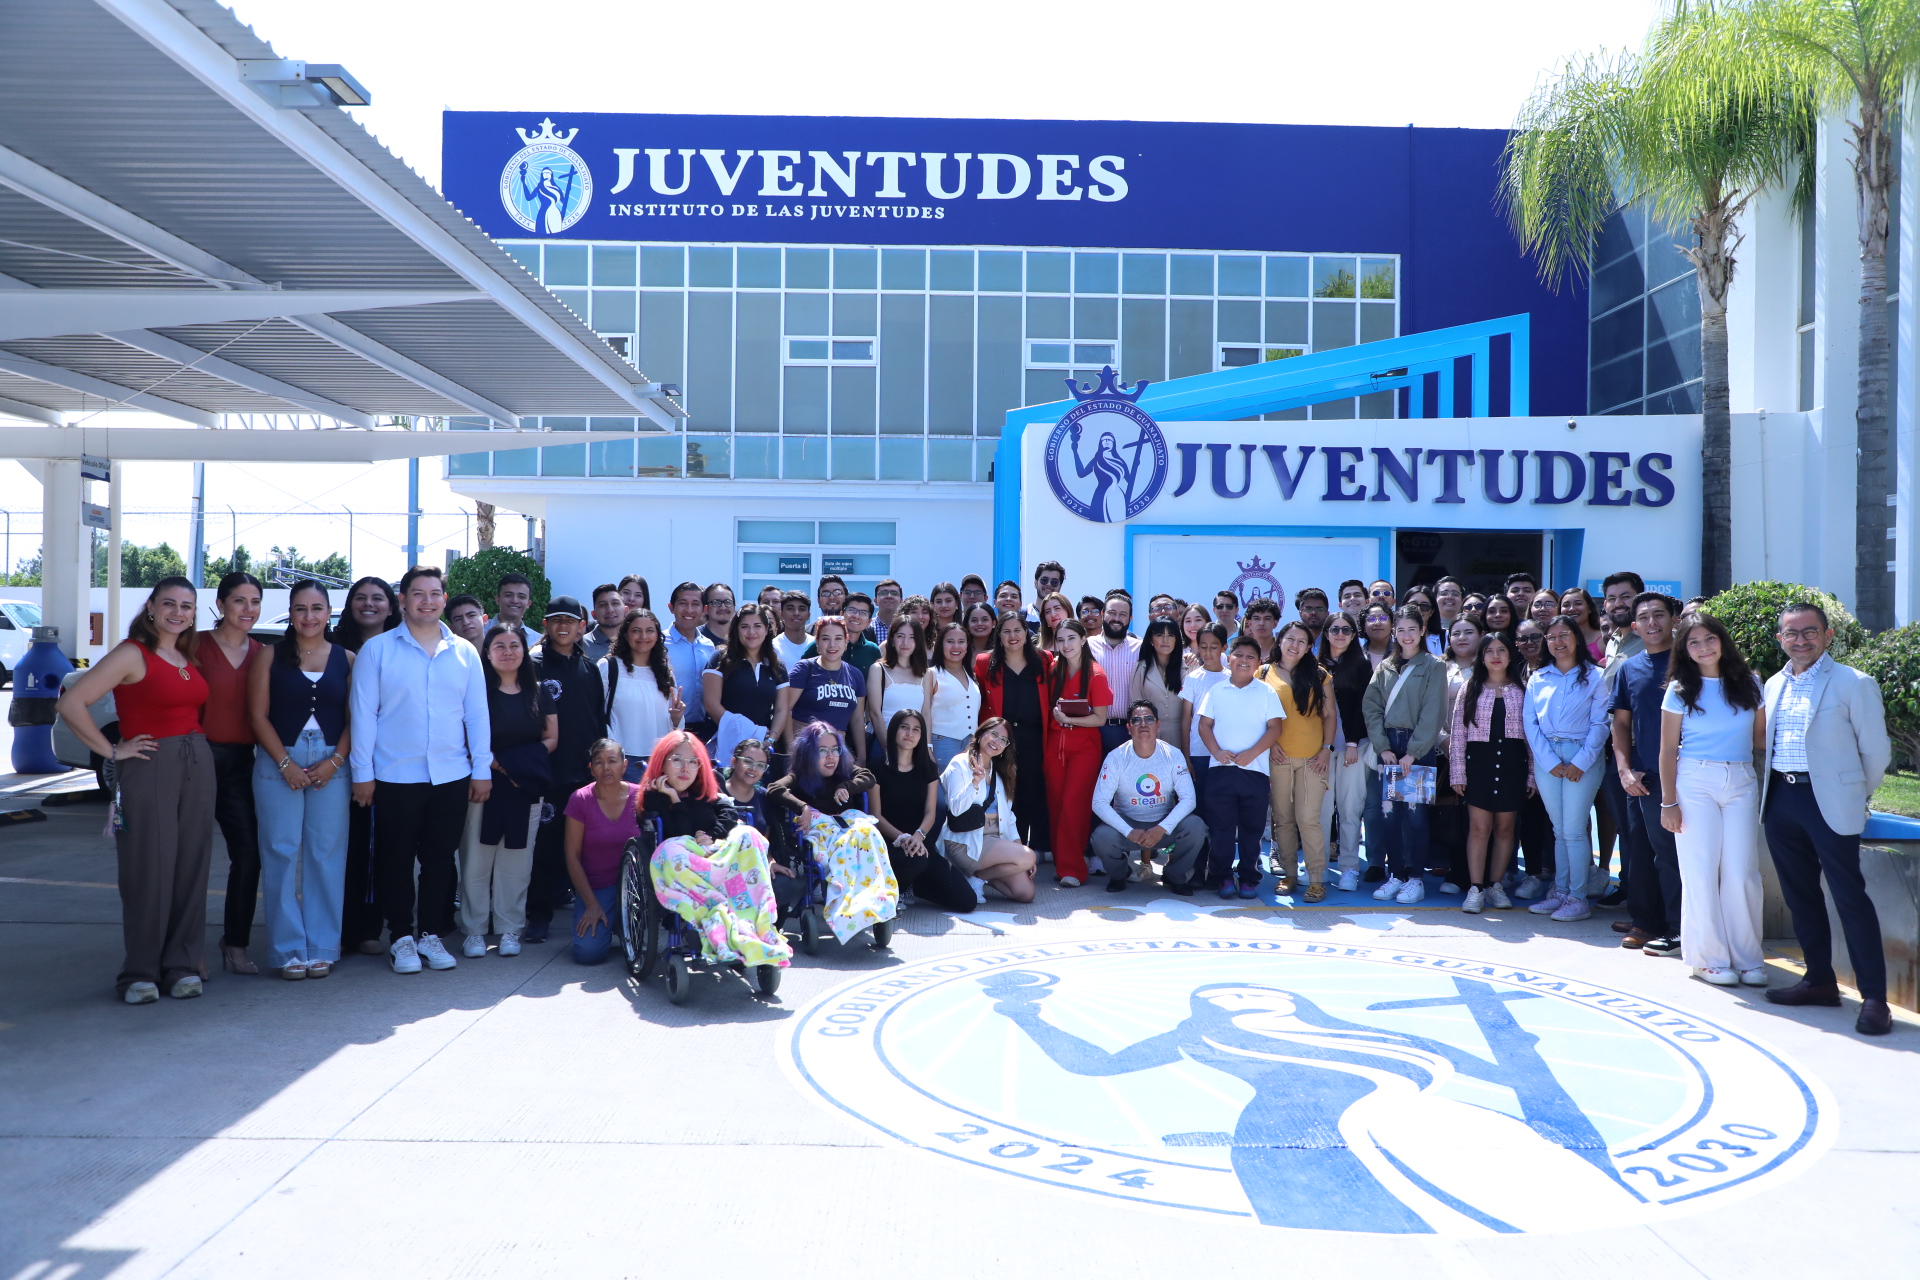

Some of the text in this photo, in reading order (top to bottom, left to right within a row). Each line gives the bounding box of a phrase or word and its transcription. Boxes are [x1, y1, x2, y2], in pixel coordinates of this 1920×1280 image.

[503, 158, 519, 190] GOBIERNO
[519, 149, 530, 159] DEL
[567, 152, 590, 191] GUANAJUATO
[609, 148, 1129, 203] JUVENTUDES
[514, 212, 530, 227] 2024
[562, 212, 580, 226] 2030
[609, 203, 945, 220] INSTITUTO DE LAS JUVENTUDES
[1048, 402, 1165, 466] GOBIERNO DEL ESTADO DE GUANAJUATO
[1172, 443, 1675, 508] JUVENTUDES
[1062, 493, 1083, 513] 2024
[1127, 495, 1150, 514] 2030
[1131, 796, 1167, 806] steam
[817, 940, 1721, 1043] GOBIERNO DEL ESTADO DE GUANAJUATO
[934, 1123, 1156, 1190] 2024
[1622, 1122, 1778, 1188] 2030
